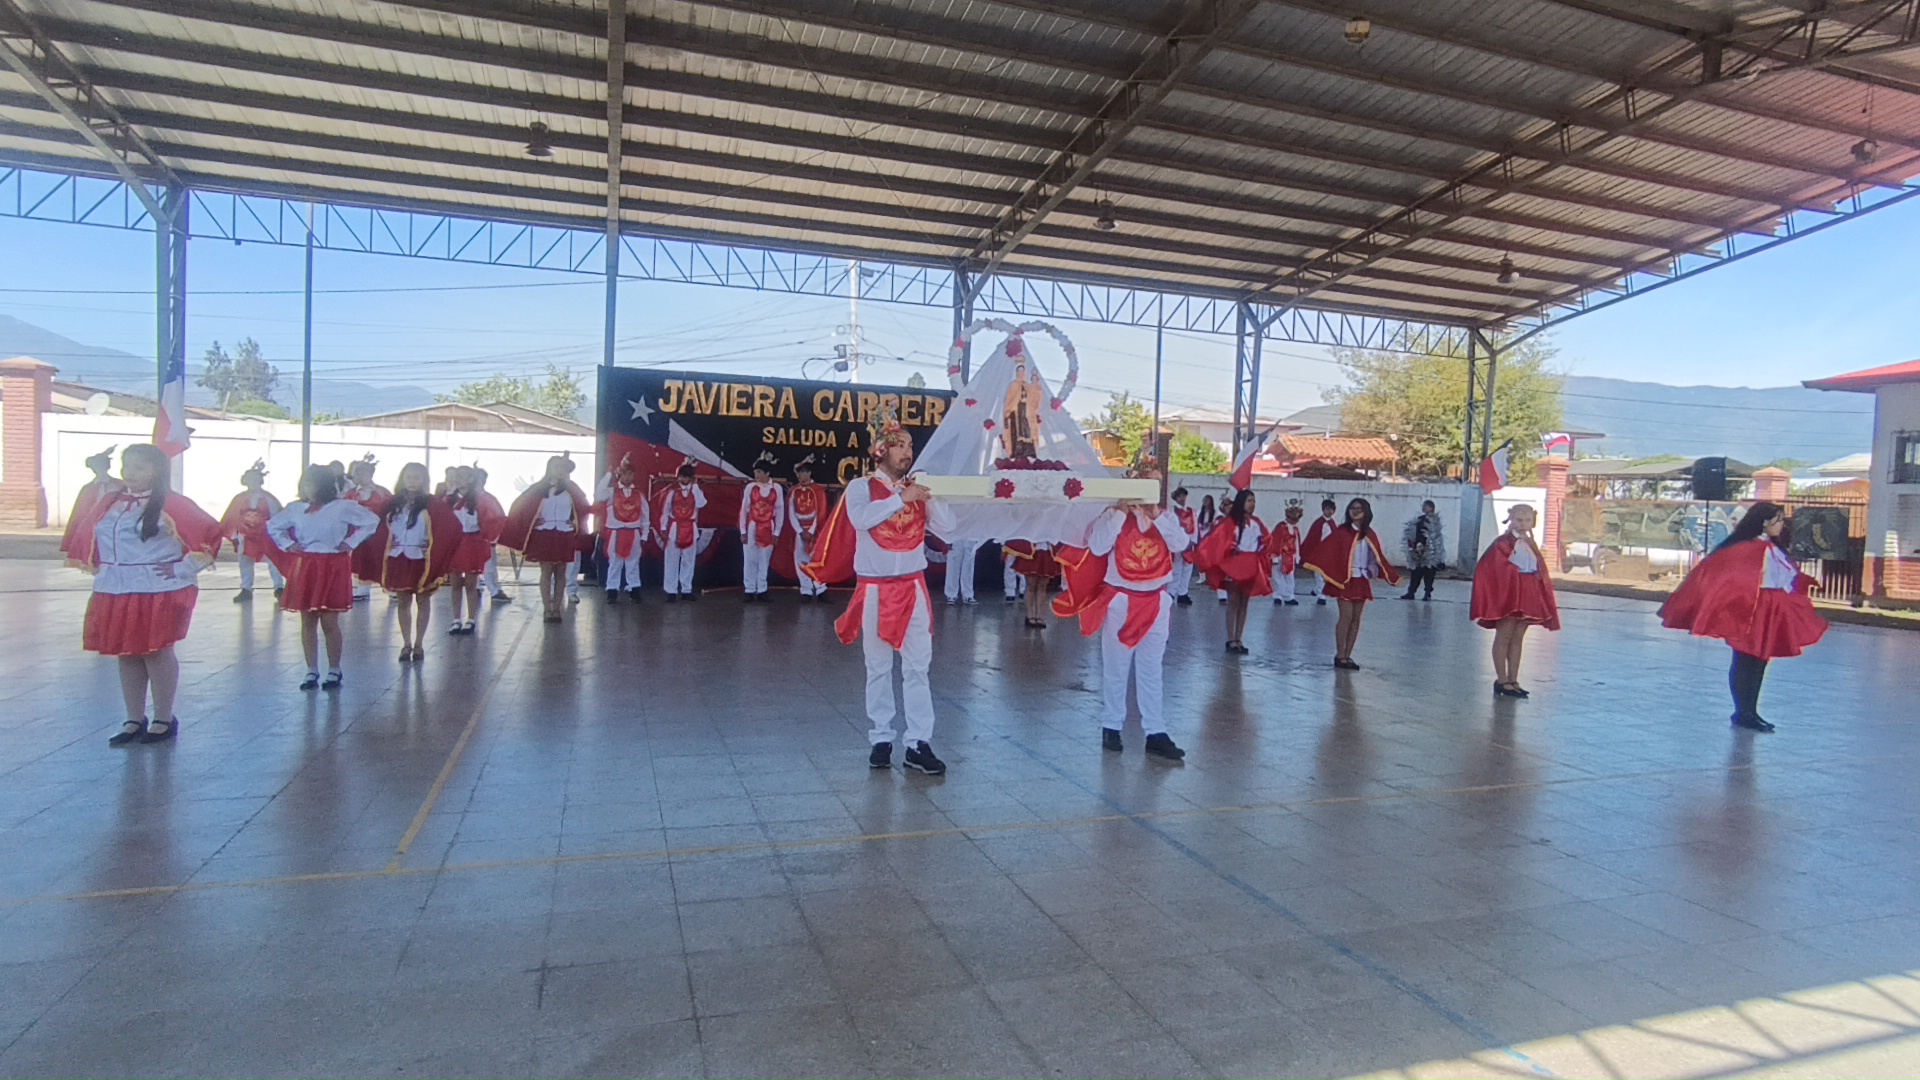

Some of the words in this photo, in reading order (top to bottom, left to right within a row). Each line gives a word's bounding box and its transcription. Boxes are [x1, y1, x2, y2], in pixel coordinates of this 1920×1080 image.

[658, 379, 799, 420] JAVIERA
[813, 389, 957, 427] CARRER
[762, 426, 837, 448] SALUDA
[847, 431, 859, 449] A
